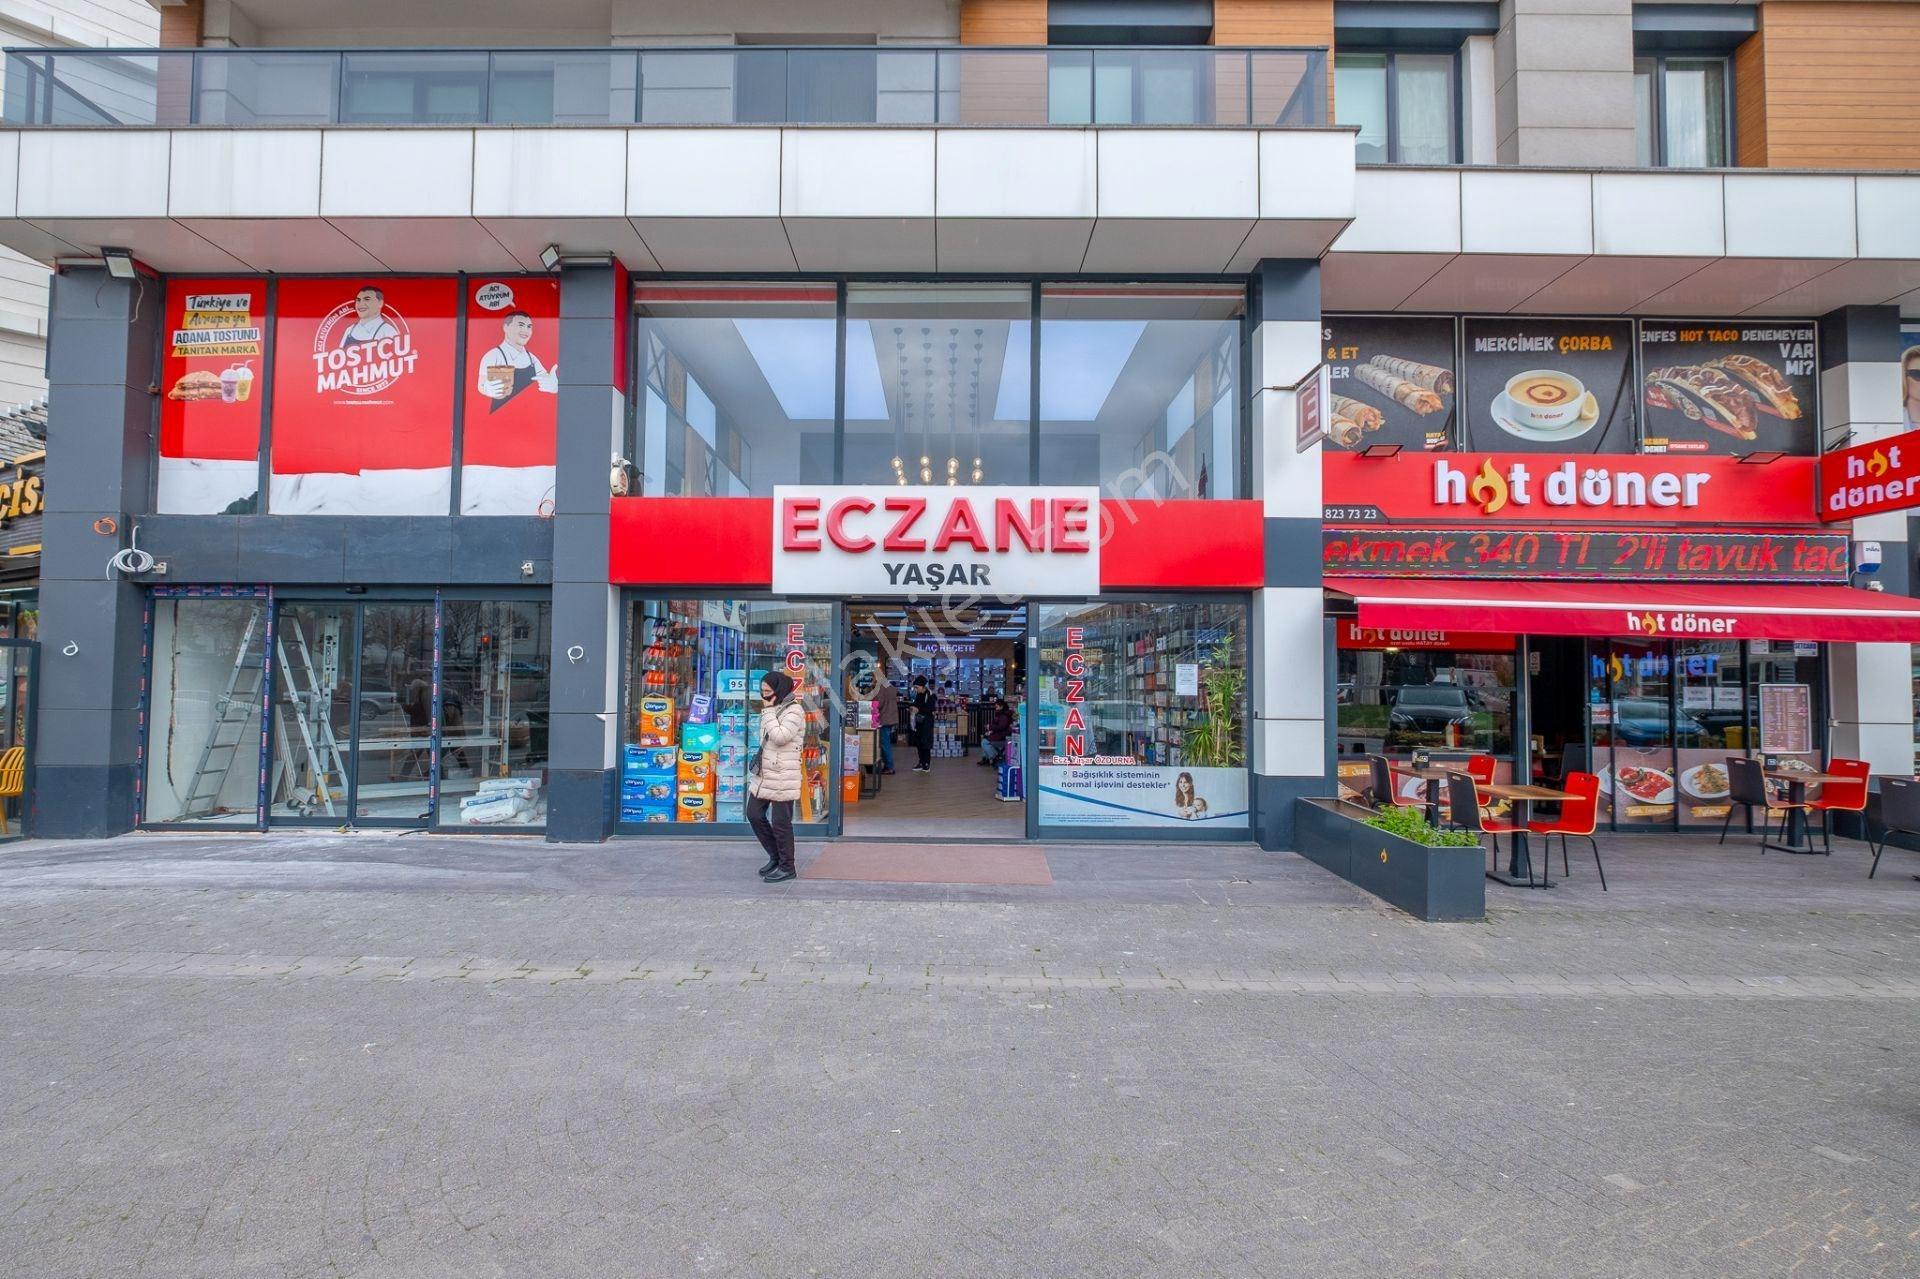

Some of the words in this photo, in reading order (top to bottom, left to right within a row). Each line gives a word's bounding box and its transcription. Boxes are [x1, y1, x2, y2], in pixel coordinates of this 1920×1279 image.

[188, 295, 232, 312] Türkiye
[236, 297, 248, 308] ve
[175, 331, 211, 344] ADANA
[213, 329, 258, 341] TOSTUNU
[1474, 333, 1554, 352] MERCİMEK
[1559, 336, 1613, 355] ÇORBA
[1680, 330, 1704, 342] HOT
[1707, 330, 1739, 342] TACO
[1742, 329, 1813, 341] DENEMEYEN
[178, 346, 218, 355] TANITAN
[221, 345, 257, 354] MARKA
[1327, 347, 1337, 360] &
[1341, 346, 1360, 360] ET
[1779, 343, 1814, 358] VAR
[317, 354, 418, 393] MAHMUT
[1330, 366, 1350, 379] ER
[1301, 386, 1317, 434] E
[1847, 445, 1901, 479] hot
[1434, 457, 1531, 515] hot
[1544, 461, 1712, 508] döner
[1829, 474, 1920, 512] döner
[781, 496, 1091, 553] ECZANE
[1324, 509, 1345, 520] 823
[1347, 509, 1360, 520] 73
[1364, 509, 1377, 520] 23
[1677, 537, 1784, 571] tavuk
[882, 563, 991, 591] YAŞAR
[1626, 612, 1666, 635] hot
[1670, 613, 1738, 633] döner
[1063, 627, 1086, 758] ECZAN
[1061, 780, 1092, 788] normal
[1094, 780, 1124, 790] işlevini
[1072, 770, 1114, 780] Bağışıklık
[1116, 771, 1160, 779] sisteminin
